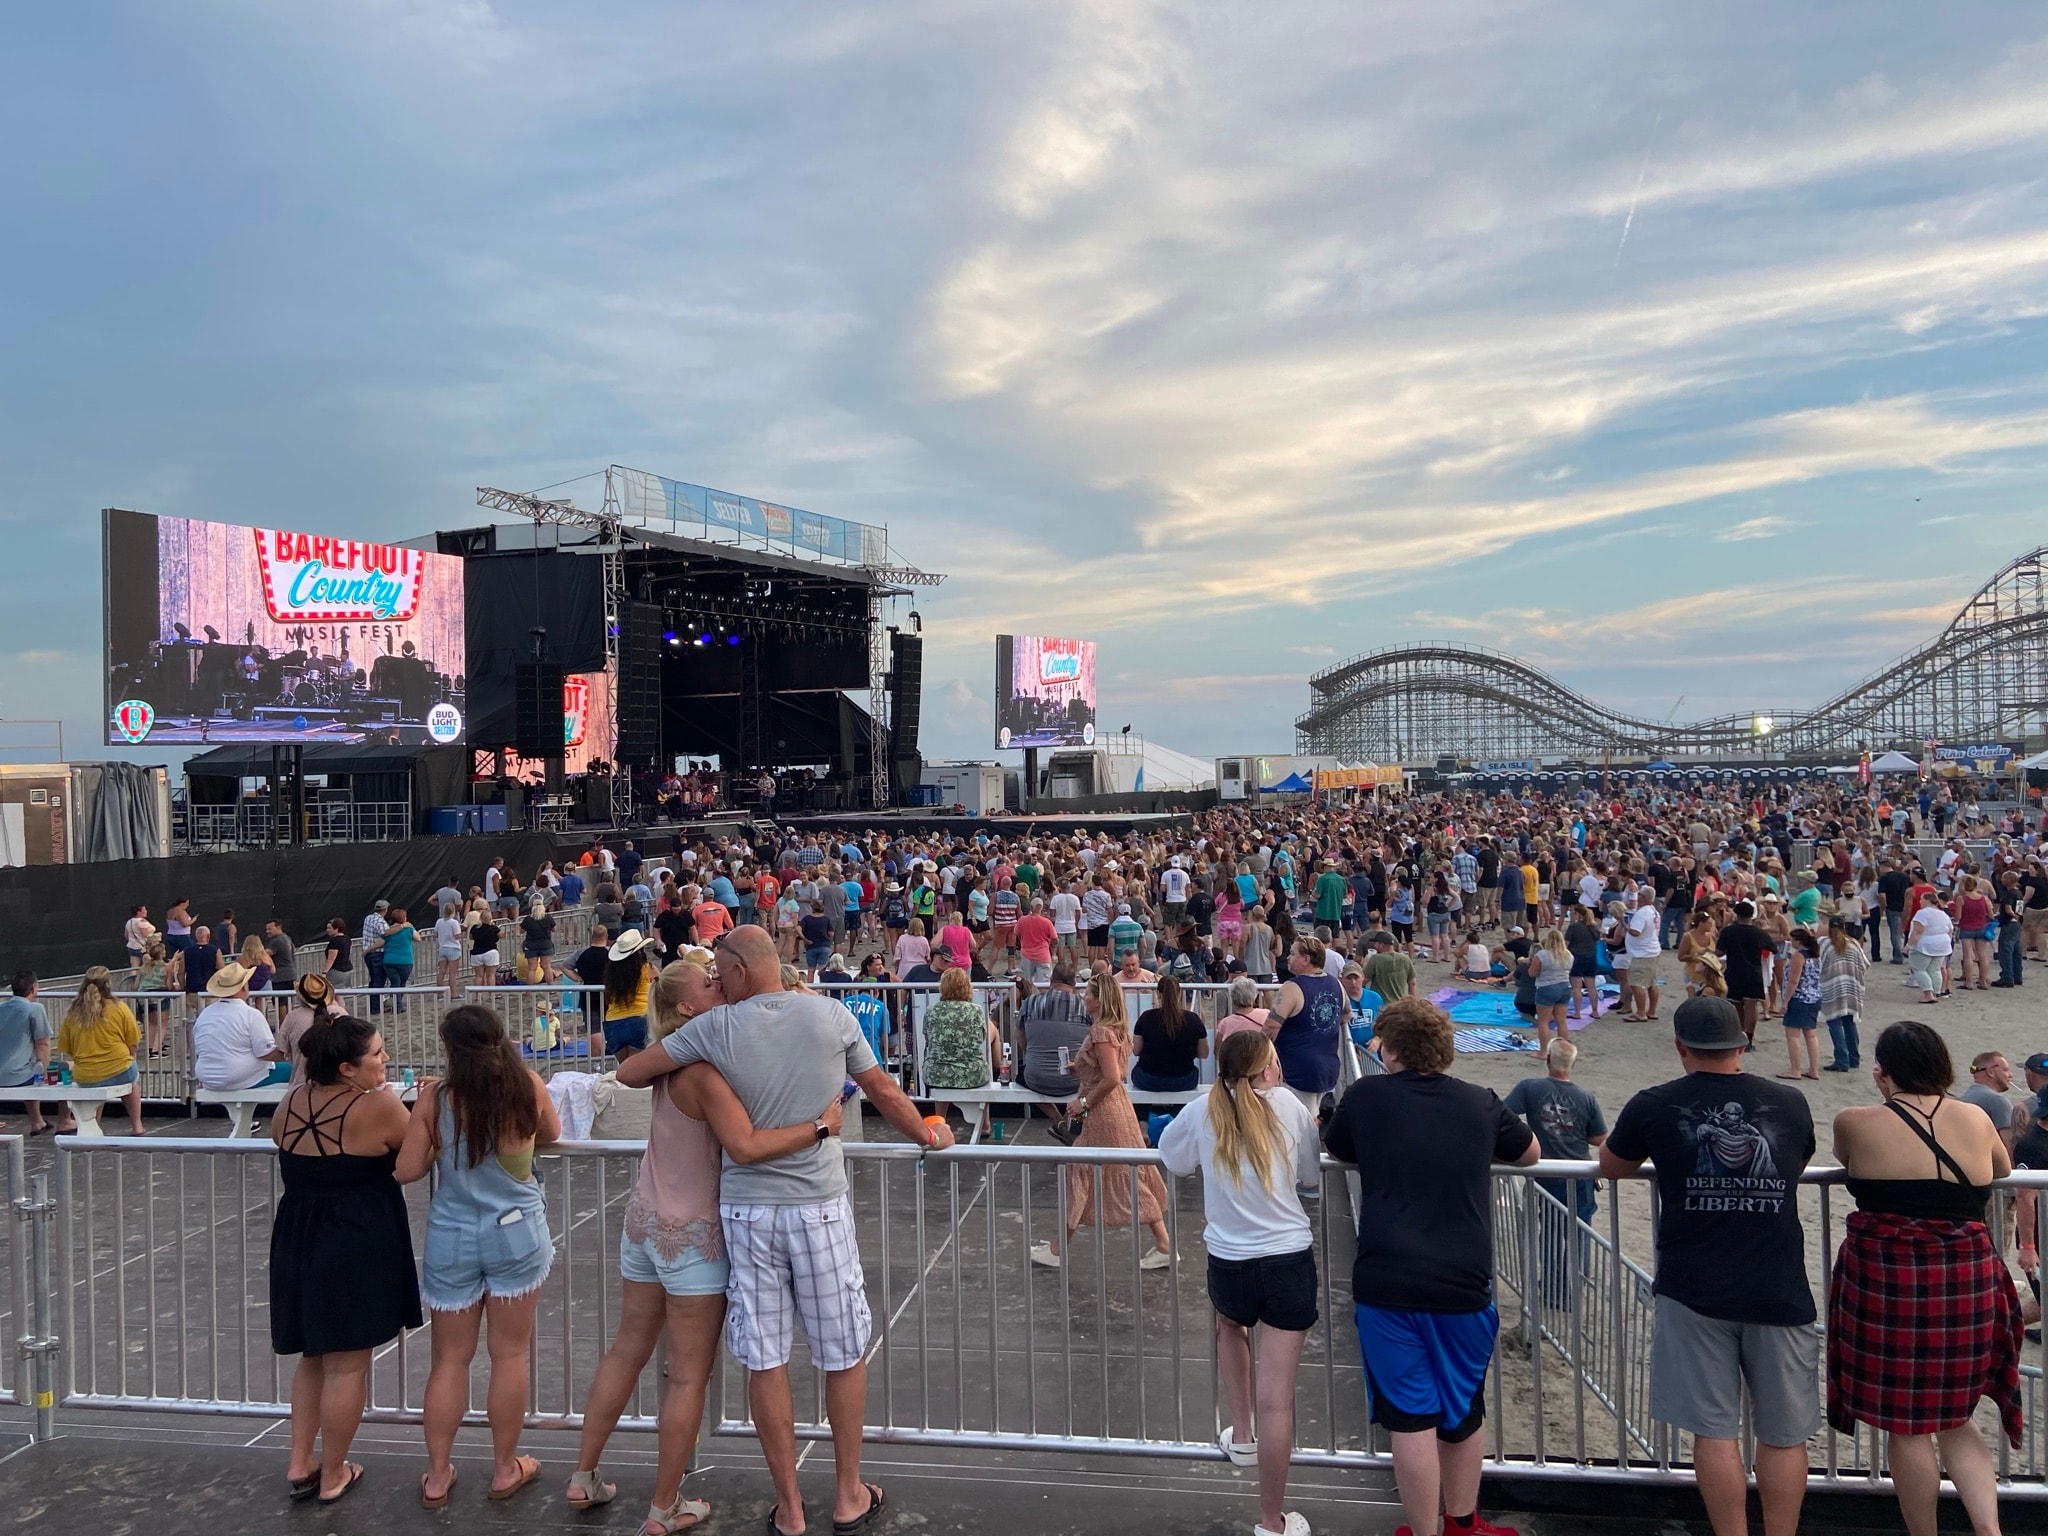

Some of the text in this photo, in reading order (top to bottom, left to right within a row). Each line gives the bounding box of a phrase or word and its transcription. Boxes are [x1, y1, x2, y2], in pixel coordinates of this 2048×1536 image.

[275, 529, 409, 577] BAREFOOT
[288, 560, 403, 620] Country
[285, 624, 403, 641] MUSIC FEST
[1042, 637, 1080, 655] BAREFOOT
[432, 718, 458, 726] LIGHT
[435, 710, 454, 718] BUD
[1967, 745, 2011, 758] Colada
[1488, 761, 1527, 770] SEA ISLE
[845, 1000, 880, 1016] STAFF
[1685, 1177, 1786, 1191] DEFENDING
[1684, 1197, 1784, 1214] LIBERTY
